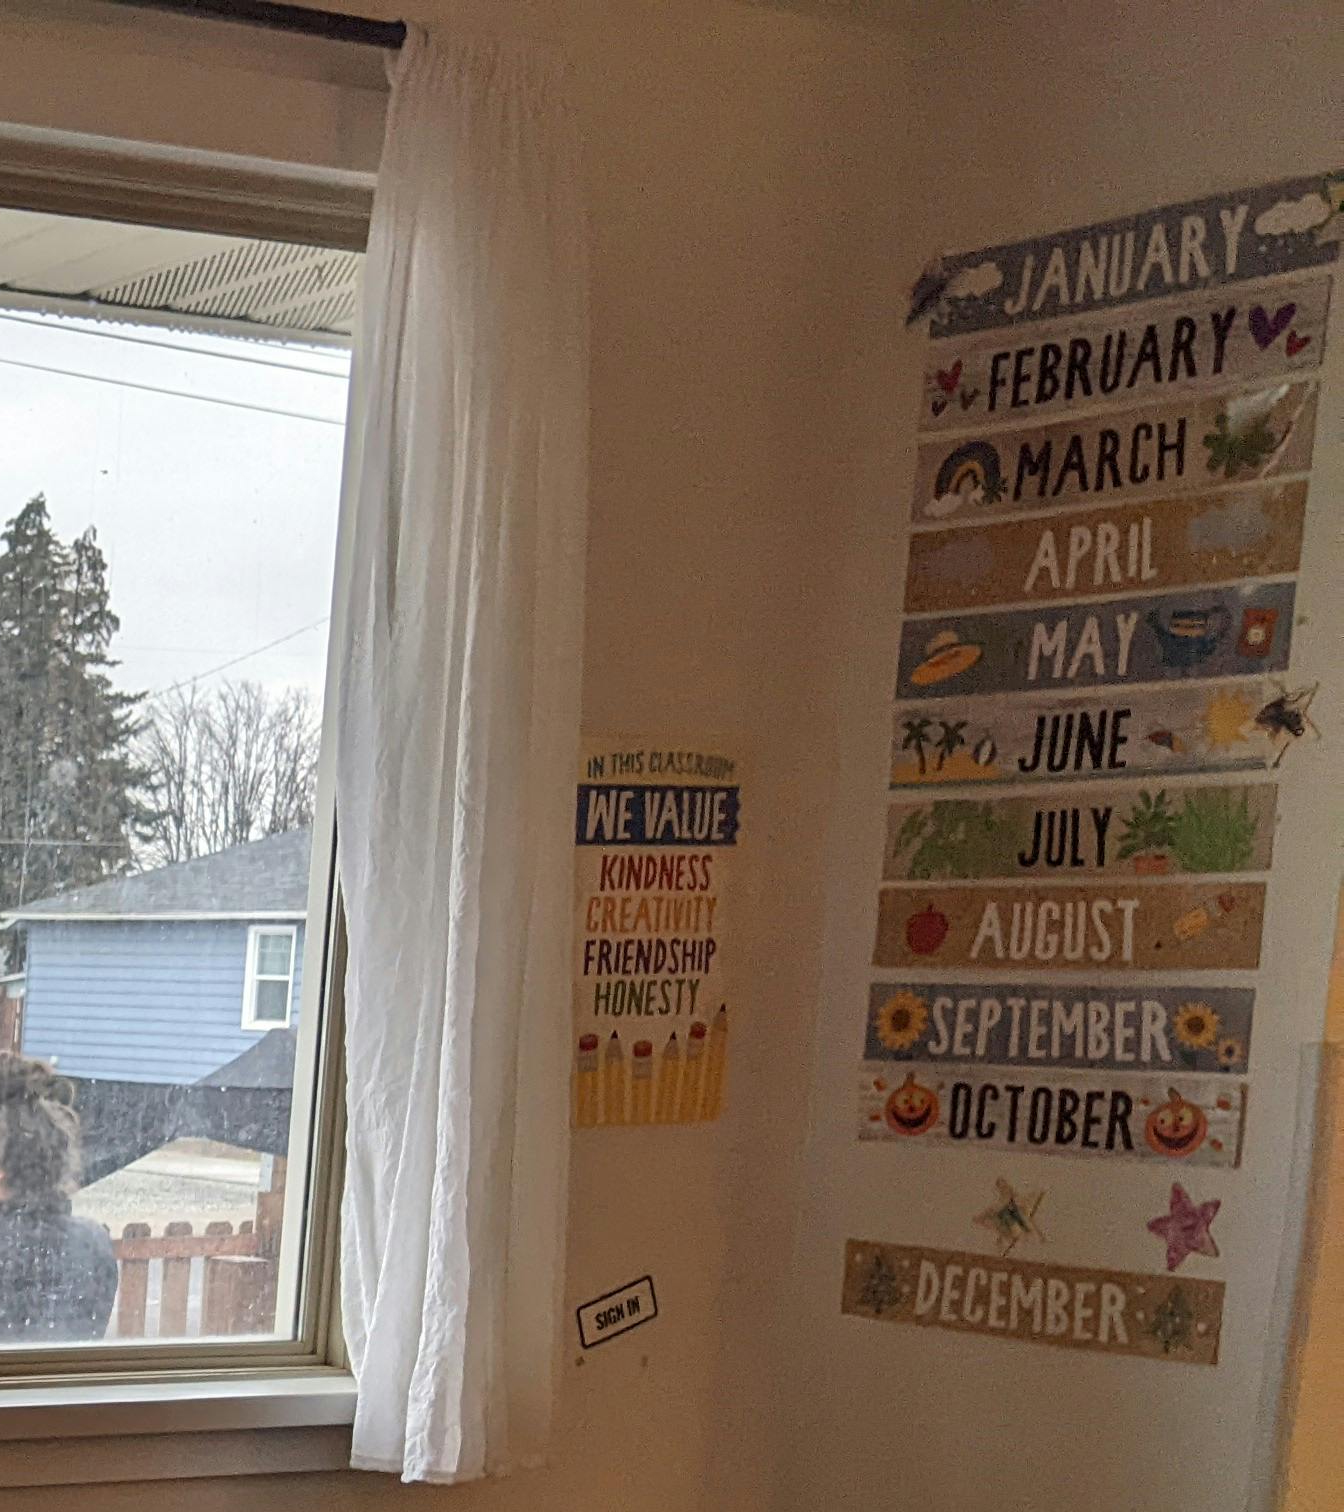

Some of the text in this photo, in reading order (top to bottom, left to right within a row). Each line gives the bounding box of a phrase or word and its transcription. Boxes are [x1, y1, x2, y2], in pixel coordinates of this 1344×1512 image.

[1003, 204, 1249, 316] JANUARY
[987, 306, 1237, 413] FEBRUARY
[1013, 418, 1188, 501] MARCH
[1023, 516, 1159, 591] APRIL
[1026, 611, 1140, 681] MAY
[587, 755, 605, 779] IN
[612, 750, 645, 776] THIS
[1018, 708, 1133, 775] JUNE
[586, 789, 728, 841] WE VALUE
[1017, 807, 1113, 869] JULY
[599, 854, 714, 892] KINDNESS
[585, 897, 717, 934] CREATIVITY
[970, 899, 1140, 963] AUGUST
[583, 938, 717, 976] FRIENDSHIP
[594, 979, 701, 1017] HONESTY
[927, 997, 1174, 1063] SEPTEMBER
[948, 1080, 1136, 1151] OCTOBER
[595, 1296, 640, 1331] SIGN IN
[913, 1260, 1130, 1344] DECEMBER
